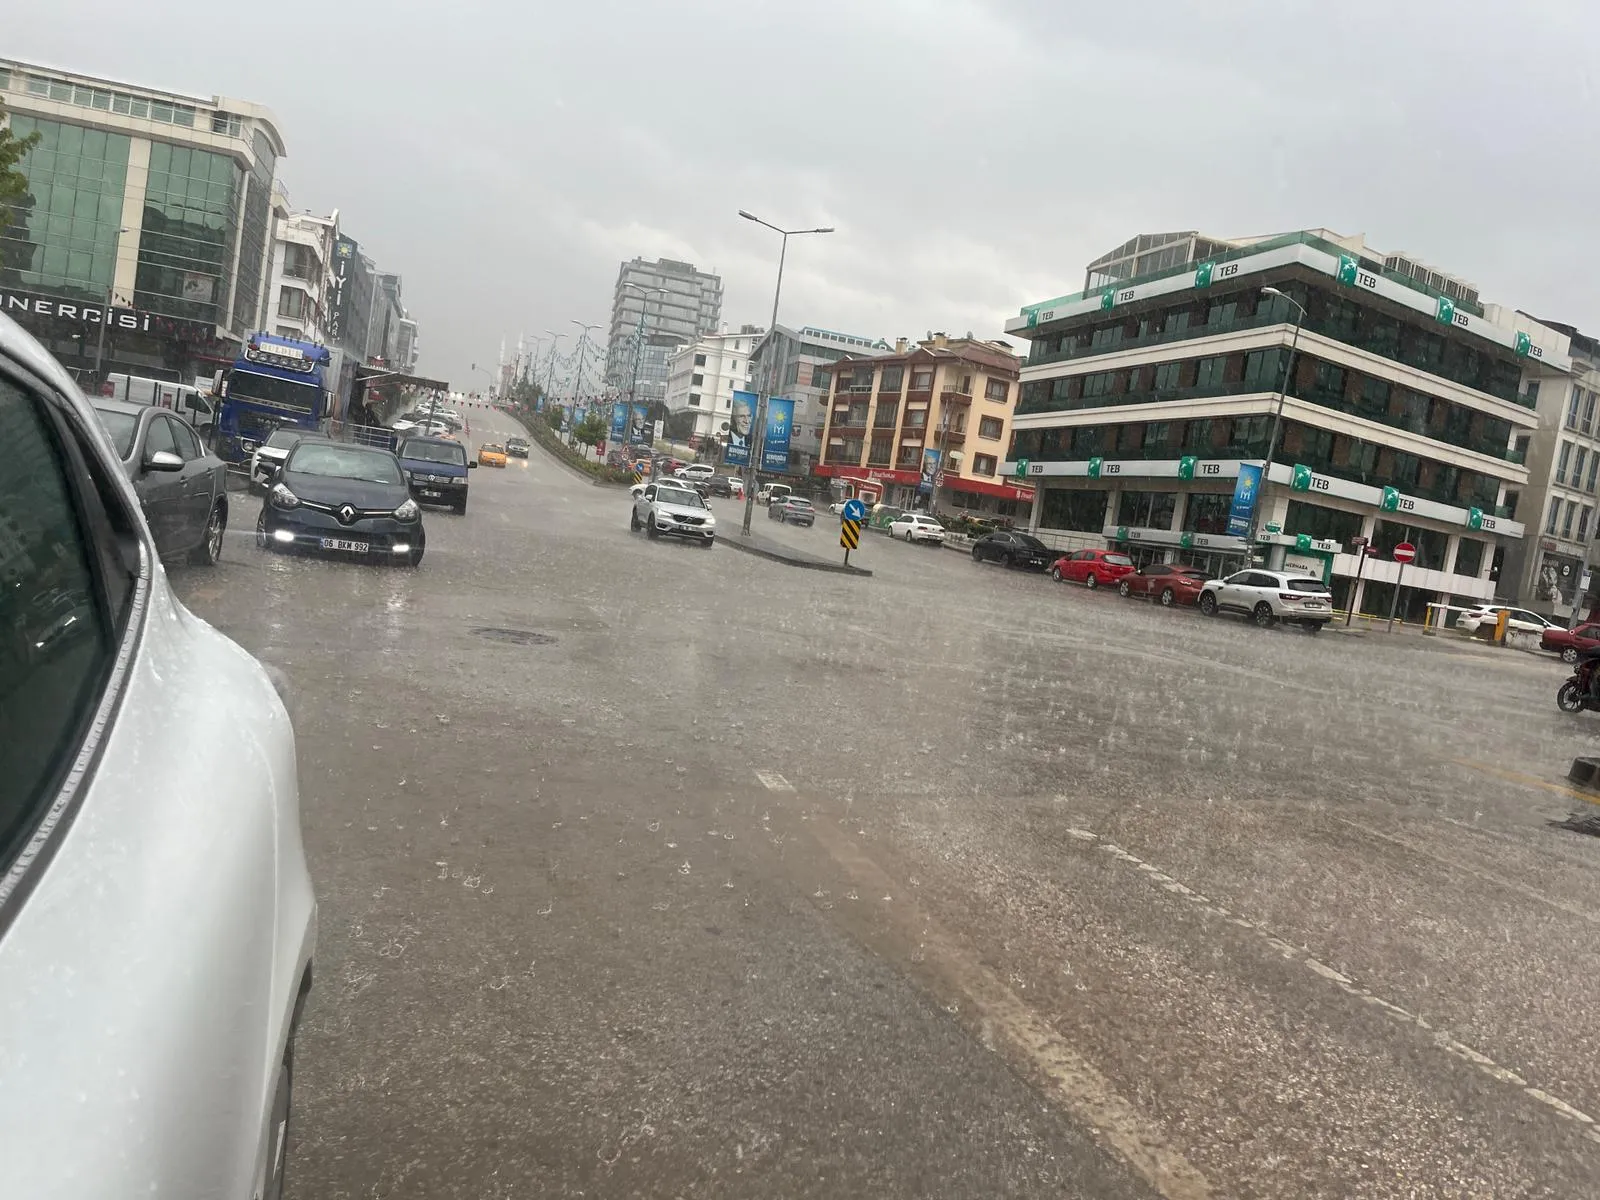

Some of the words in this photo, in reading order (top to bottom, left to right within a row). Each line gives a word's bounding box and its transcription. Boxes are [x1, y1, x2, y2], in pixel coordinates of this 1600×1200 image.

[1219, 263, 1239, 278] TEB
[1358, 272, 1377, 289] TEB
[1119, 289, 1135, 300] TEB
[1042, 310, 1054, 321] TEB
[1453, 311, 1469, 326] TEB
[1529, 344, 1543, 358] TEB
[1031, 464, 1044, 474] TEB
[1106, 464, 1121, 474] TEB
[1202, 464, 1221, 475] TEB
[1311, 476, 1330, 491] TEB
[1398, 497, 1415, 511] TEB
[1482, 517, 1496, 530] TEB
[1130, 531, 1141, 539] TEB
[324, 539, 334, 548] 06
[354, 542, 368, 552] 992
[1197, 537, 1209, 546] TEB
[1316, 542, 1331, 550] TEB
